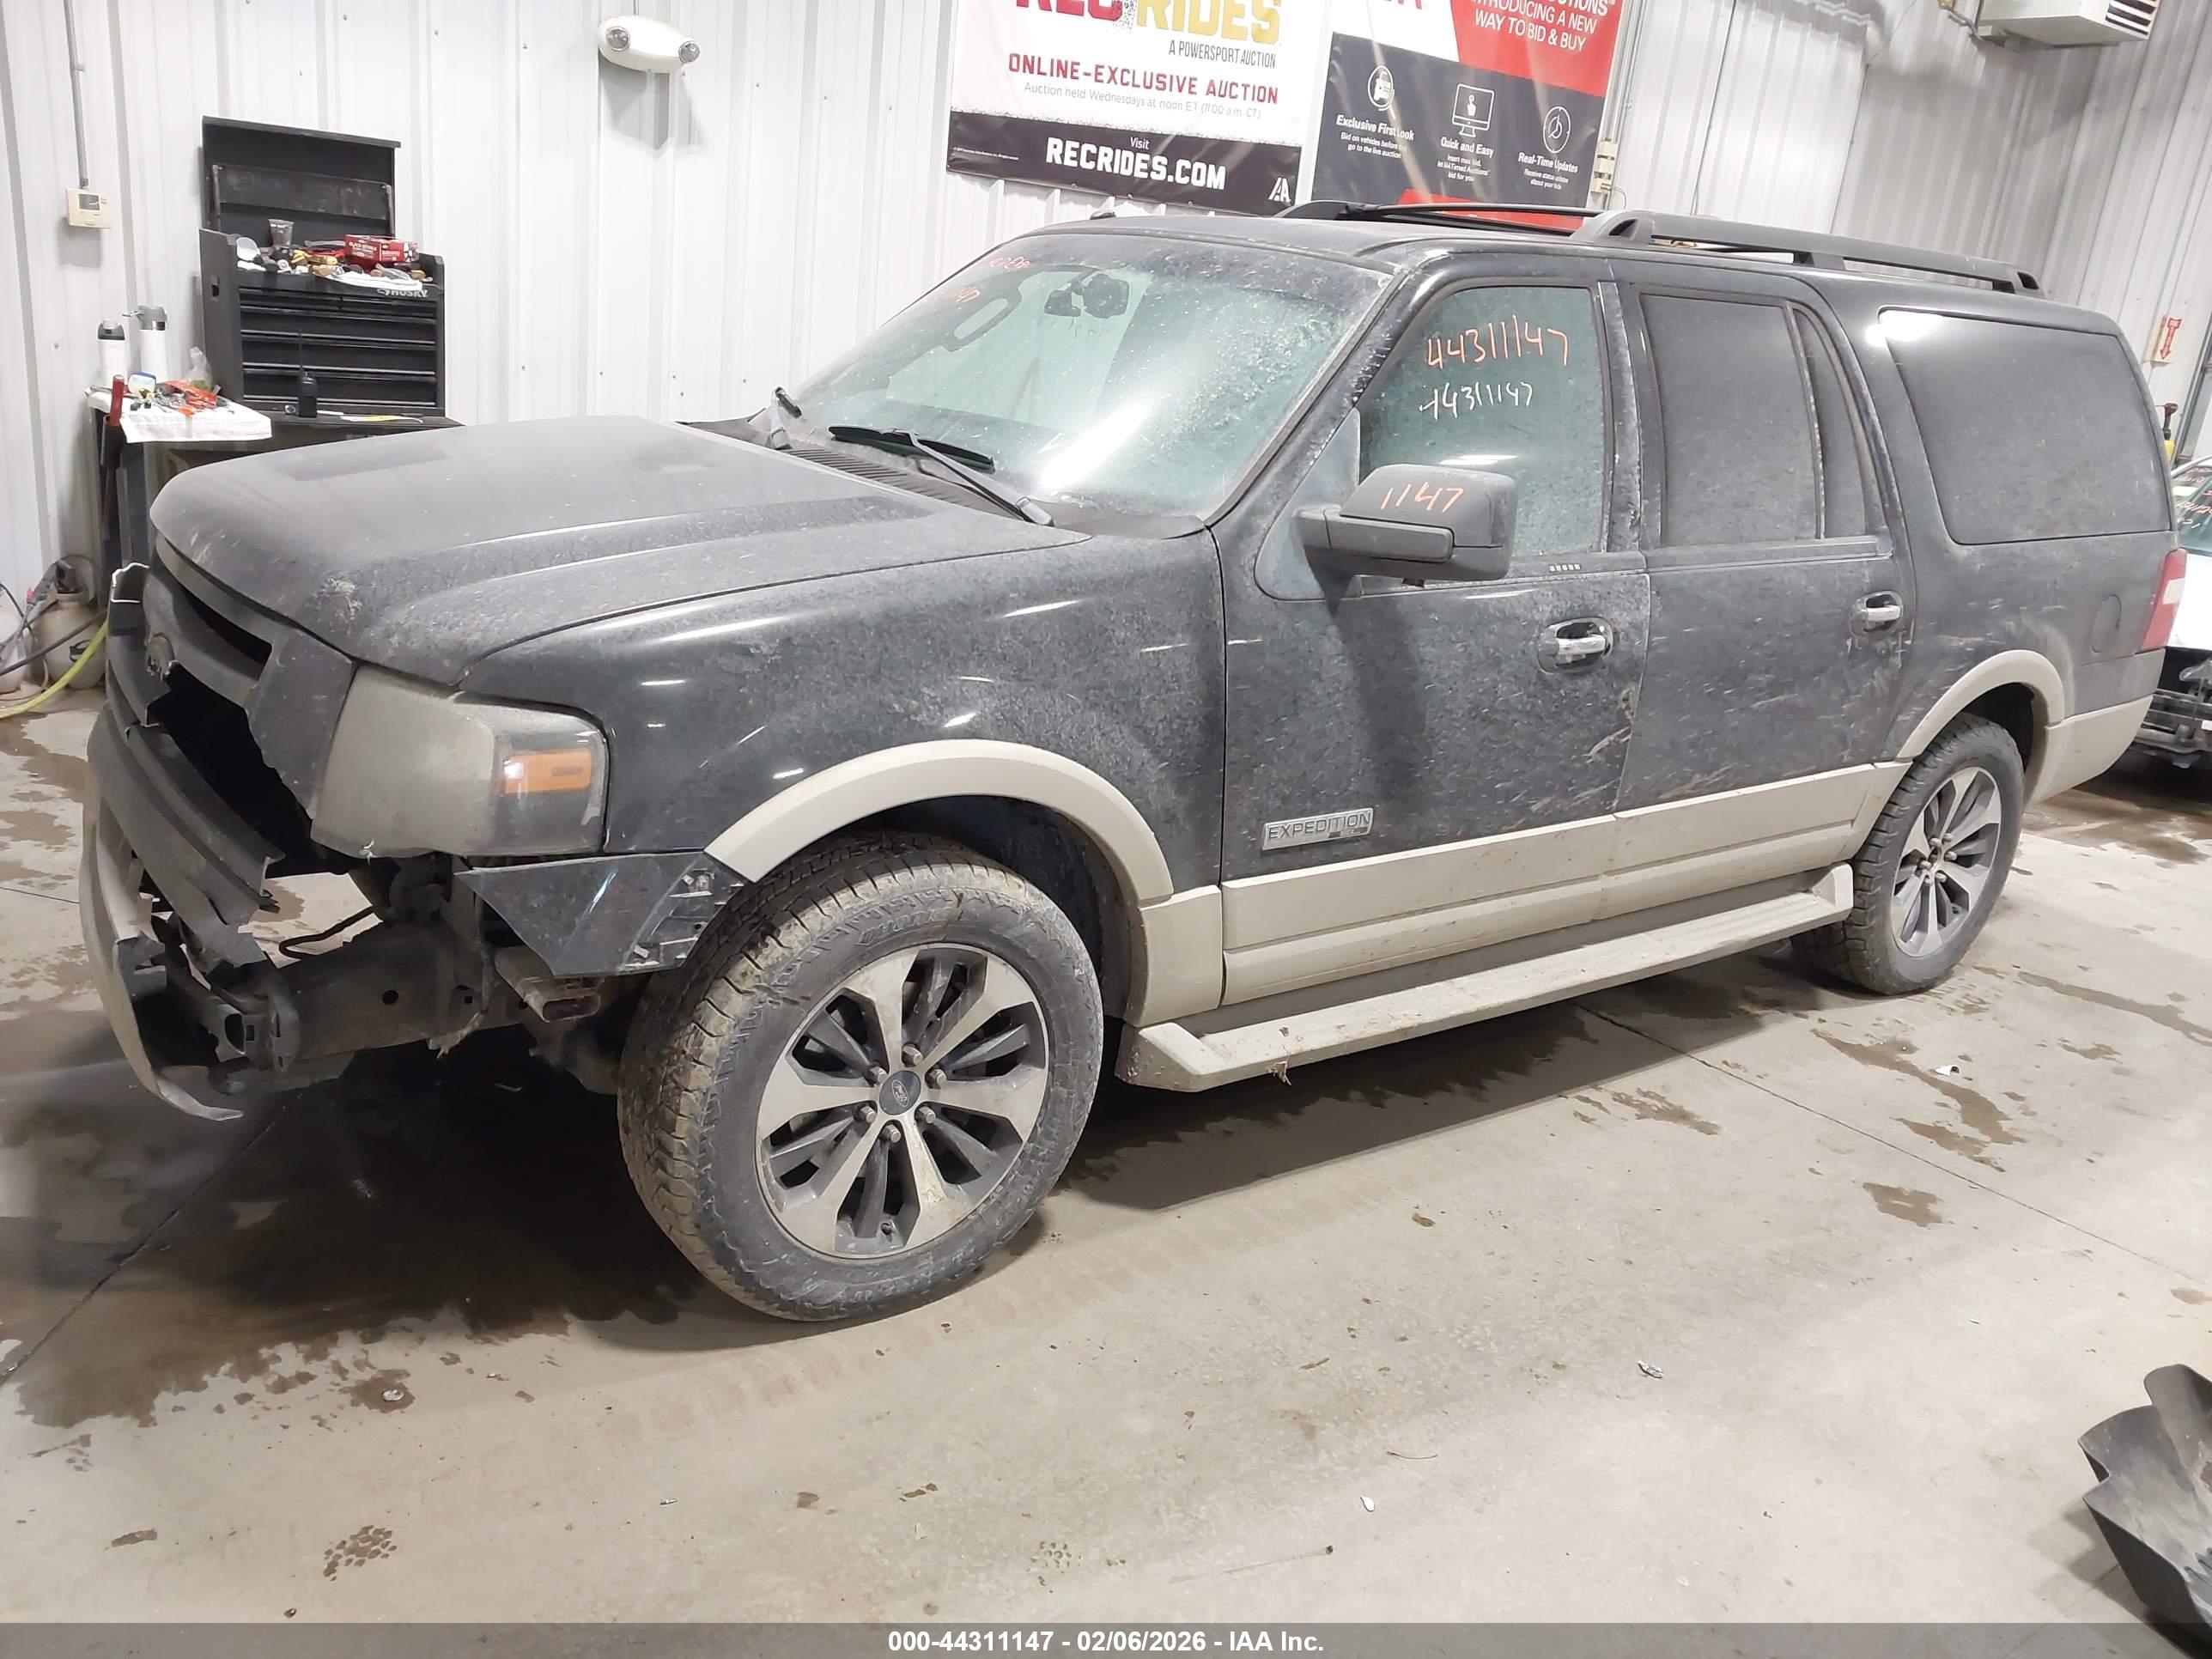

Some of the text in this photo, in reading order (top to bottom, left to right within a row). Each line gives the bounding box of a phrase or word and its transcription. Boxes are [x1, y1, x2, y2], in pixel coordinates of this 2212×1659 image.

[1475, 9, 1587, 52] WAY TO BID & BUY
[1557, 10, 1566, 27] A
[1569, 13, 1598, 34] NEW
[1169, 40, 1277, 69] A POWERSPORT AUCTION
[1008, 52, 1279, 104] ONLINE-EXCLUSIVE AUCTION
[1024, 82, 1062, 97] Auction
[1066, 88, 1086, 99] held
[1089, 89, 1146, 107] Wednesdays
[1147, 98, 1157, 108] at
[1160, 100, 1183, 111] noon
[1186, 102, 1198, 112] ET
[1246, 107, 1261, 119] CT)
[1336, 114, 1415, 141] Exclusive First Look
[1340, 131, 1352, 141] Bid
[1129, 137, 1151, 150] Visit
[1357, 143, 1362, 151] to
[1382, 149, 1401, 159] auction
[1440, 136, 1495, 158] Quick and Easy
[1046, 137, 1227, 190] RECRIDES.COM
[1518, 151, 1579, 173] Real-Time Updates
[1426, 314, 1568, 369] 44311147
[1380, 481, 1464, 513] 1147
[1268, 812, 1372, 840] EXPEDITION
